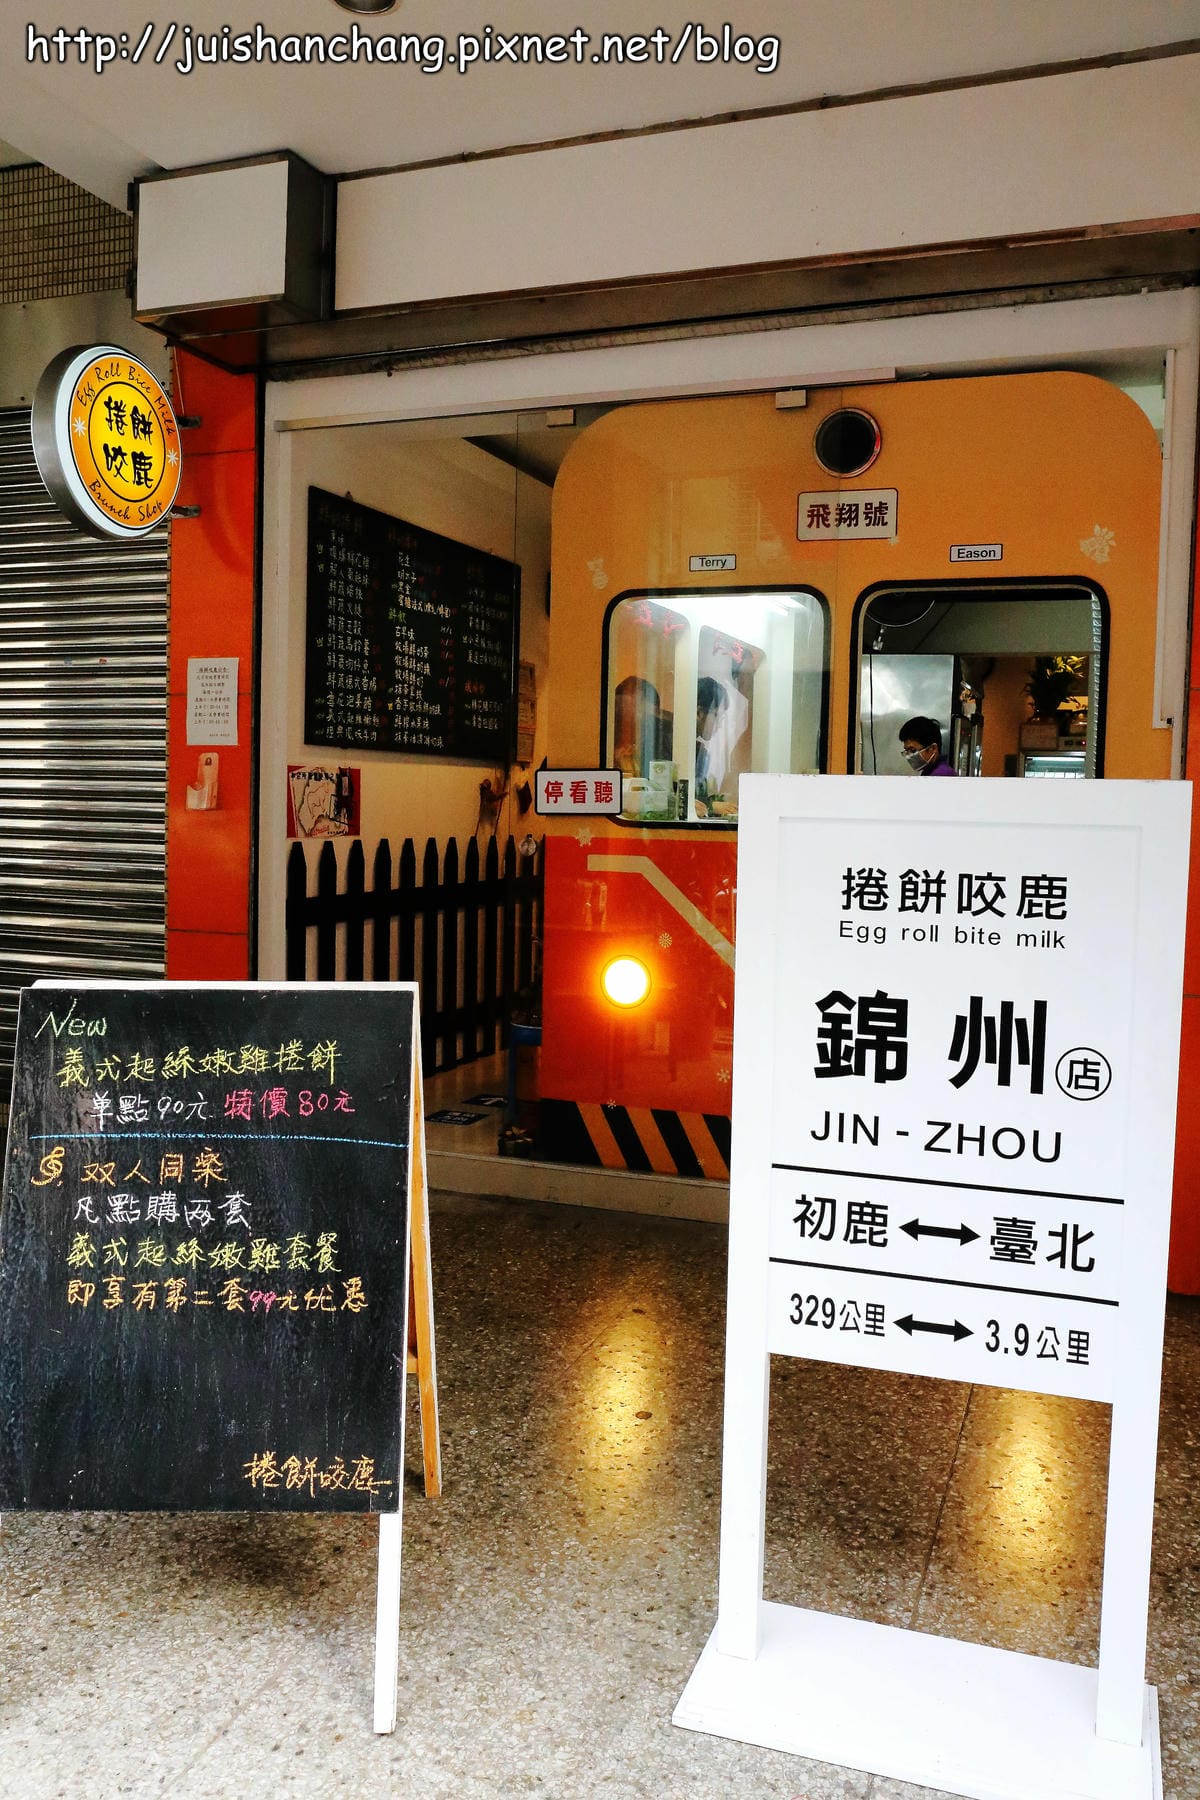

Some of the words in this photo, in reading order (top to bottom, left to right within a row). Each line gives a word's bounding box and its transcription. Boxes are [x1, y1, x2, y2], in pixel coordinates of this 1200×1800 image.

[95, 362, 121, 382] Roll
[138, 499, 164, 522] Shop
[807, 500, 890, 529] 飛翔號
[698, 556, 729, 570] Terry
[957, 546, 997, 560] Eason
[544, 780, 614, 804] 停看聽
[841, 866, 1069, 921] 捲餅咬鹿
[839, 920, 887, 945] Egg
[901, 923, 939, 943] roll
[954, 926, 1002, 947] bite
[1016, 930, 1067, 950] milk
[34, 997, 109, 1040] New
[793, 1193, 889, 1248] 初鹿
[989, 1216, 1096, 1273] 臺北
[789, 1292, 886, 1338] 329公里
[985, 1319, 1091, 1367] 3.9公里
